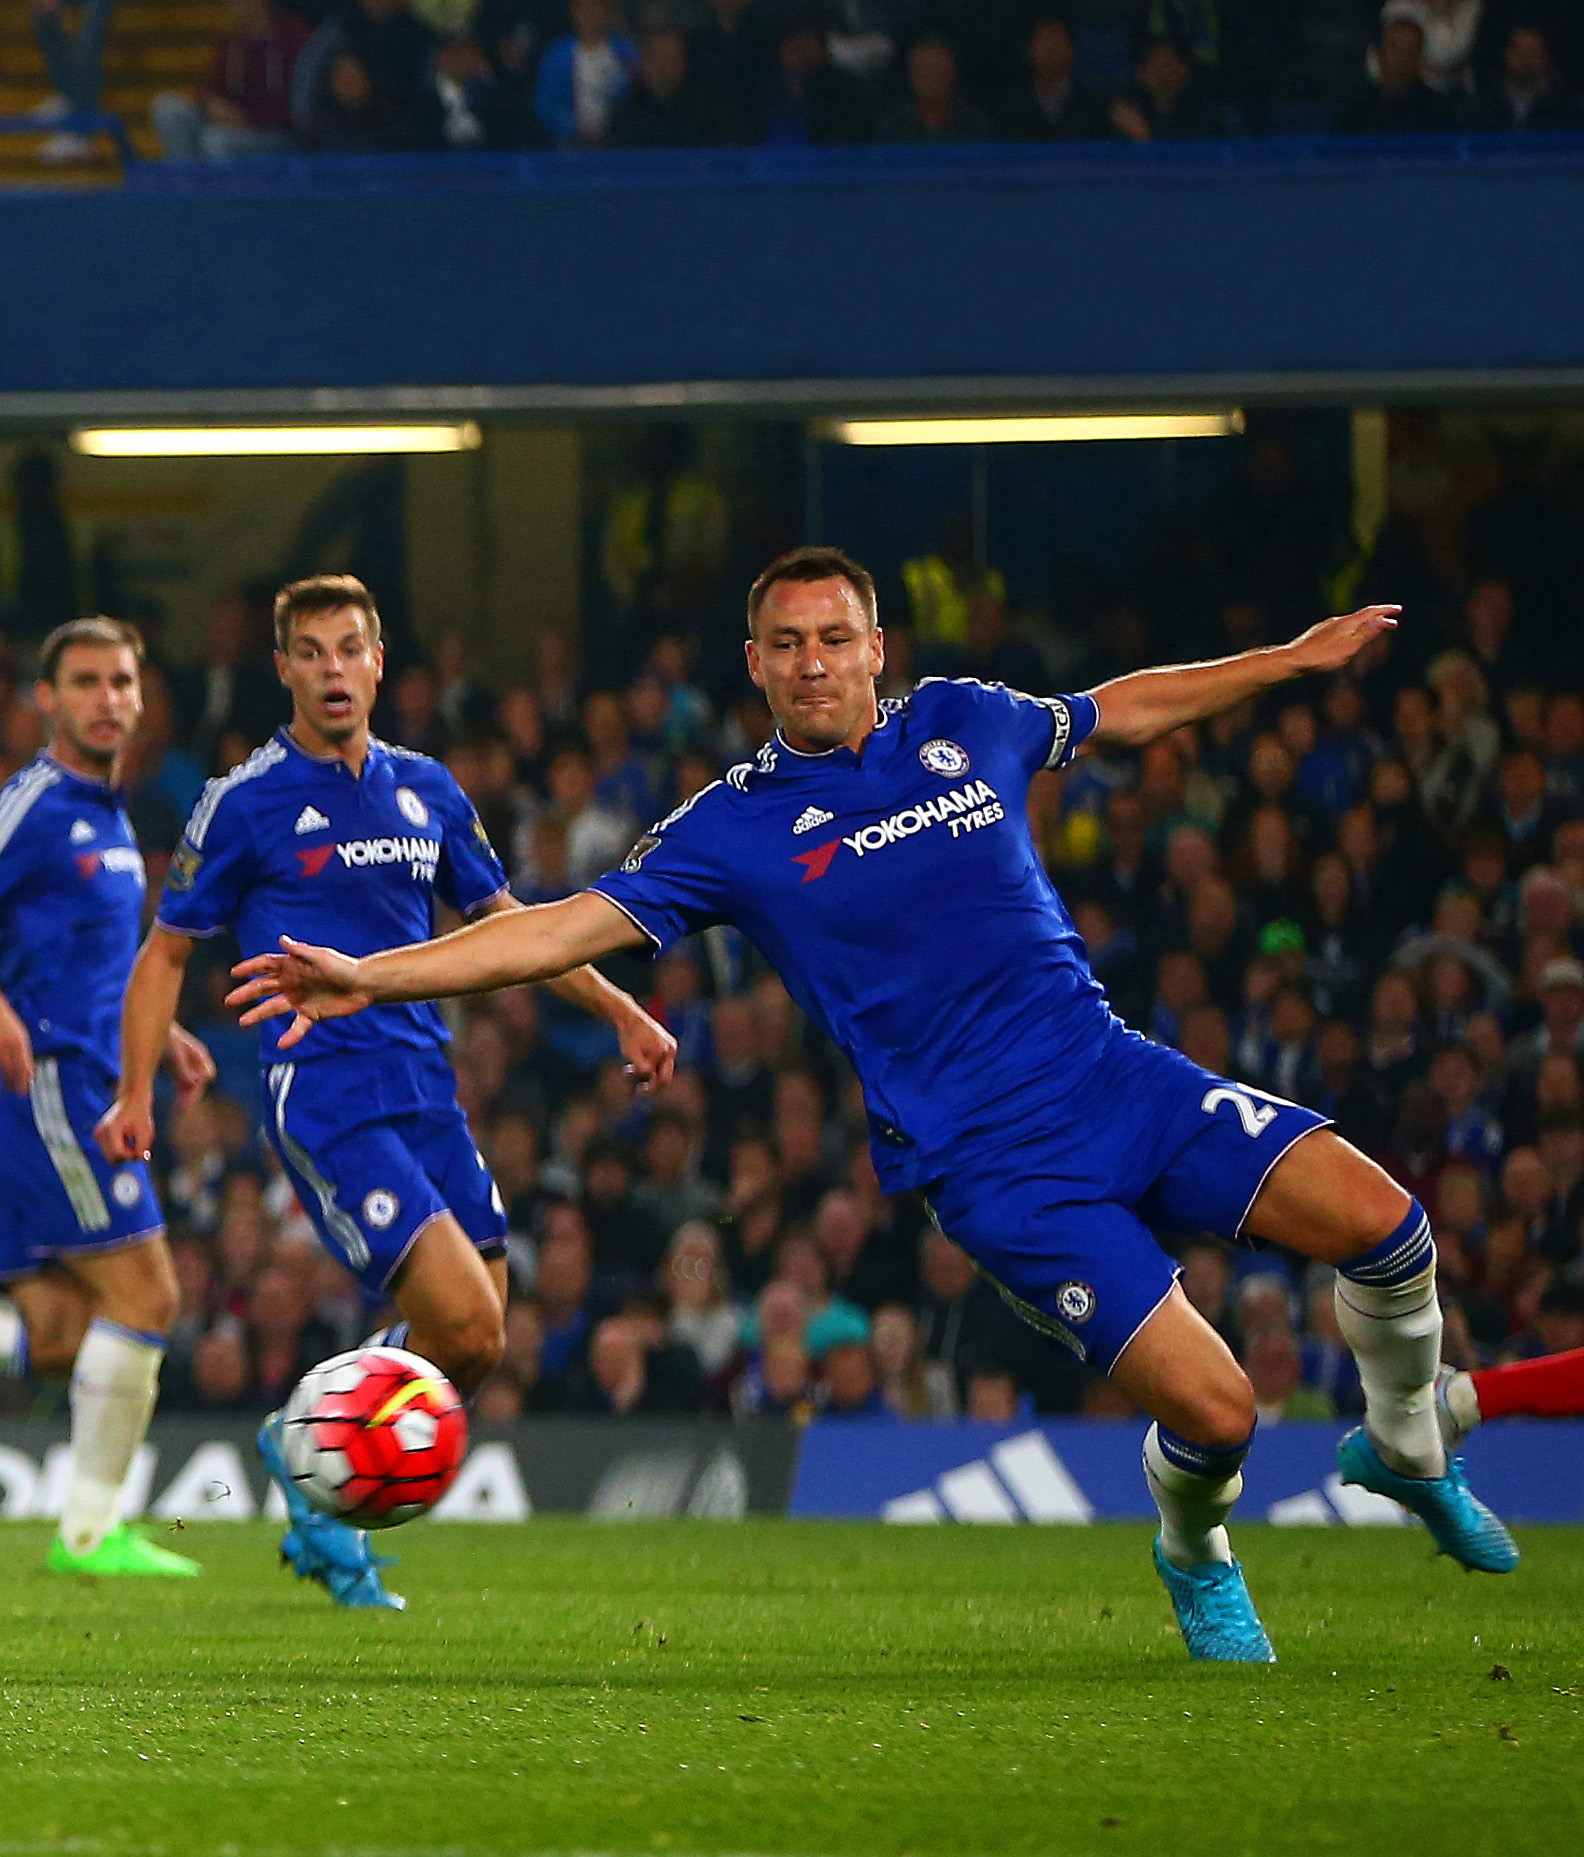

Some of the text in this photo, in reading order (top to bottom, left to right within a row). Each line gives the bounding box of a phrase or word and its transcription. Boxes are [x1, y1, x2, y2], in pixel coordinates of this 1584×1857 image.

[842, 780, 997, 857] YOKOHAMA
[948, 802, 1004, 838] TYRES
[1201, 1083, 1298, 1139] 2
